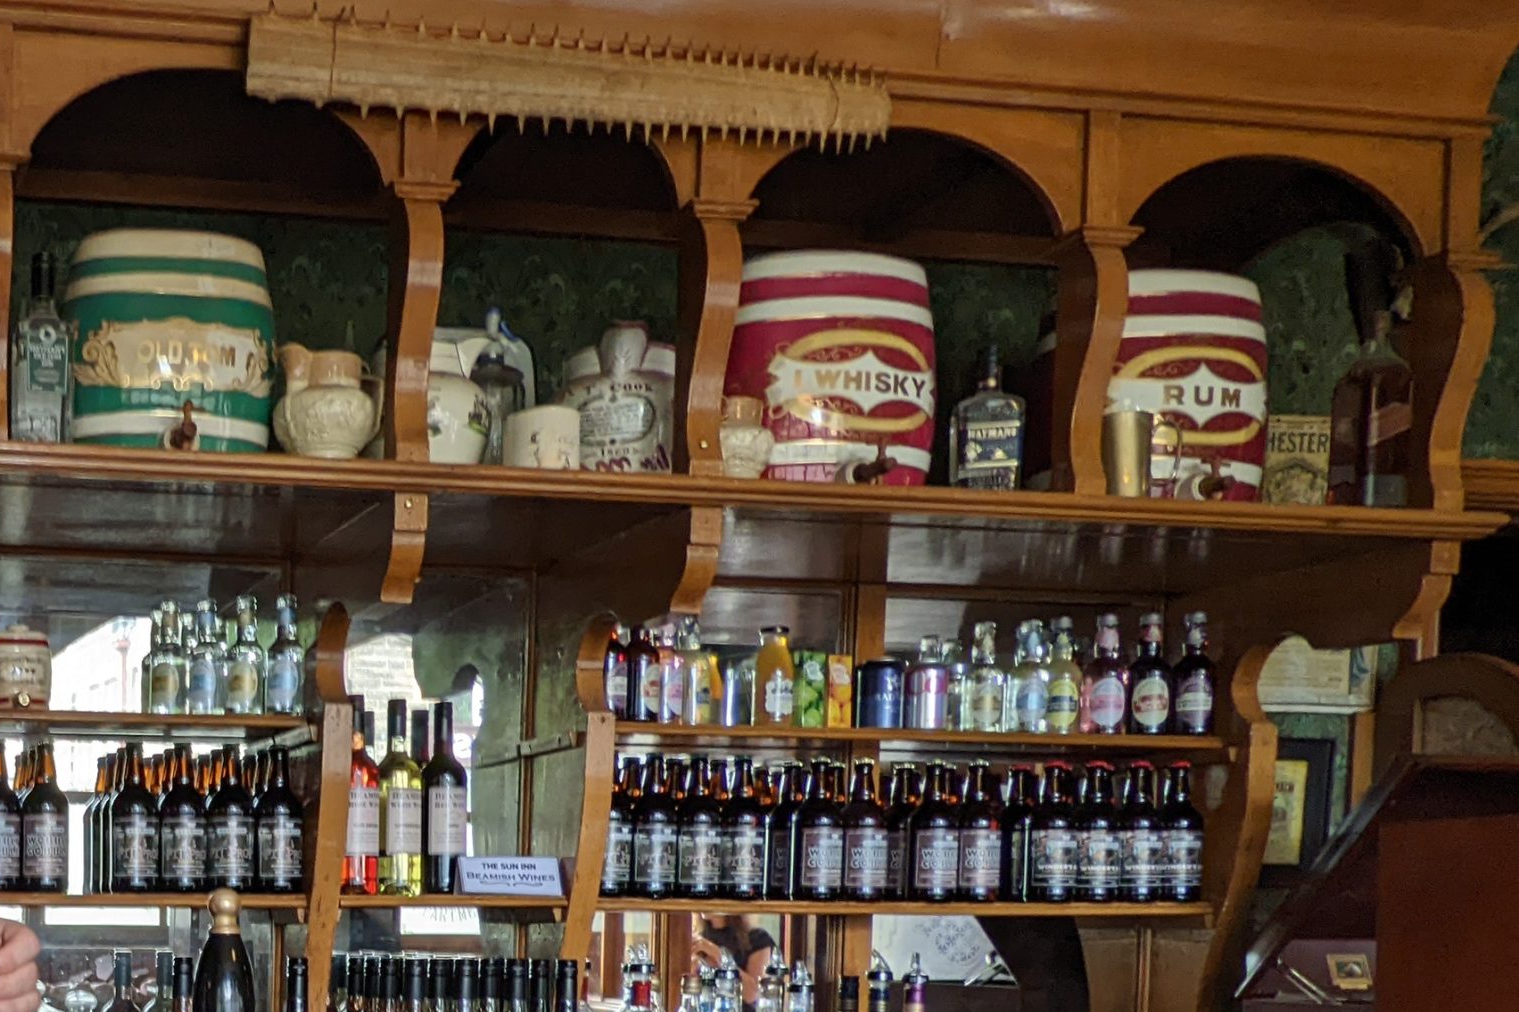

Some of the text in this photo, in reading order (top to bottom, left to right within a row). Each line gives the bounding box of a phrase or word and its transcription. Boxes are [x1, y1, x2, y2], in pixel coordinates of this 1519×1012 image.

[815, 370, 927, 398] WHISKY
[1162, 384, 1242, 409] RUM
[466, 872, 555, 882] BEAMISH WINES
